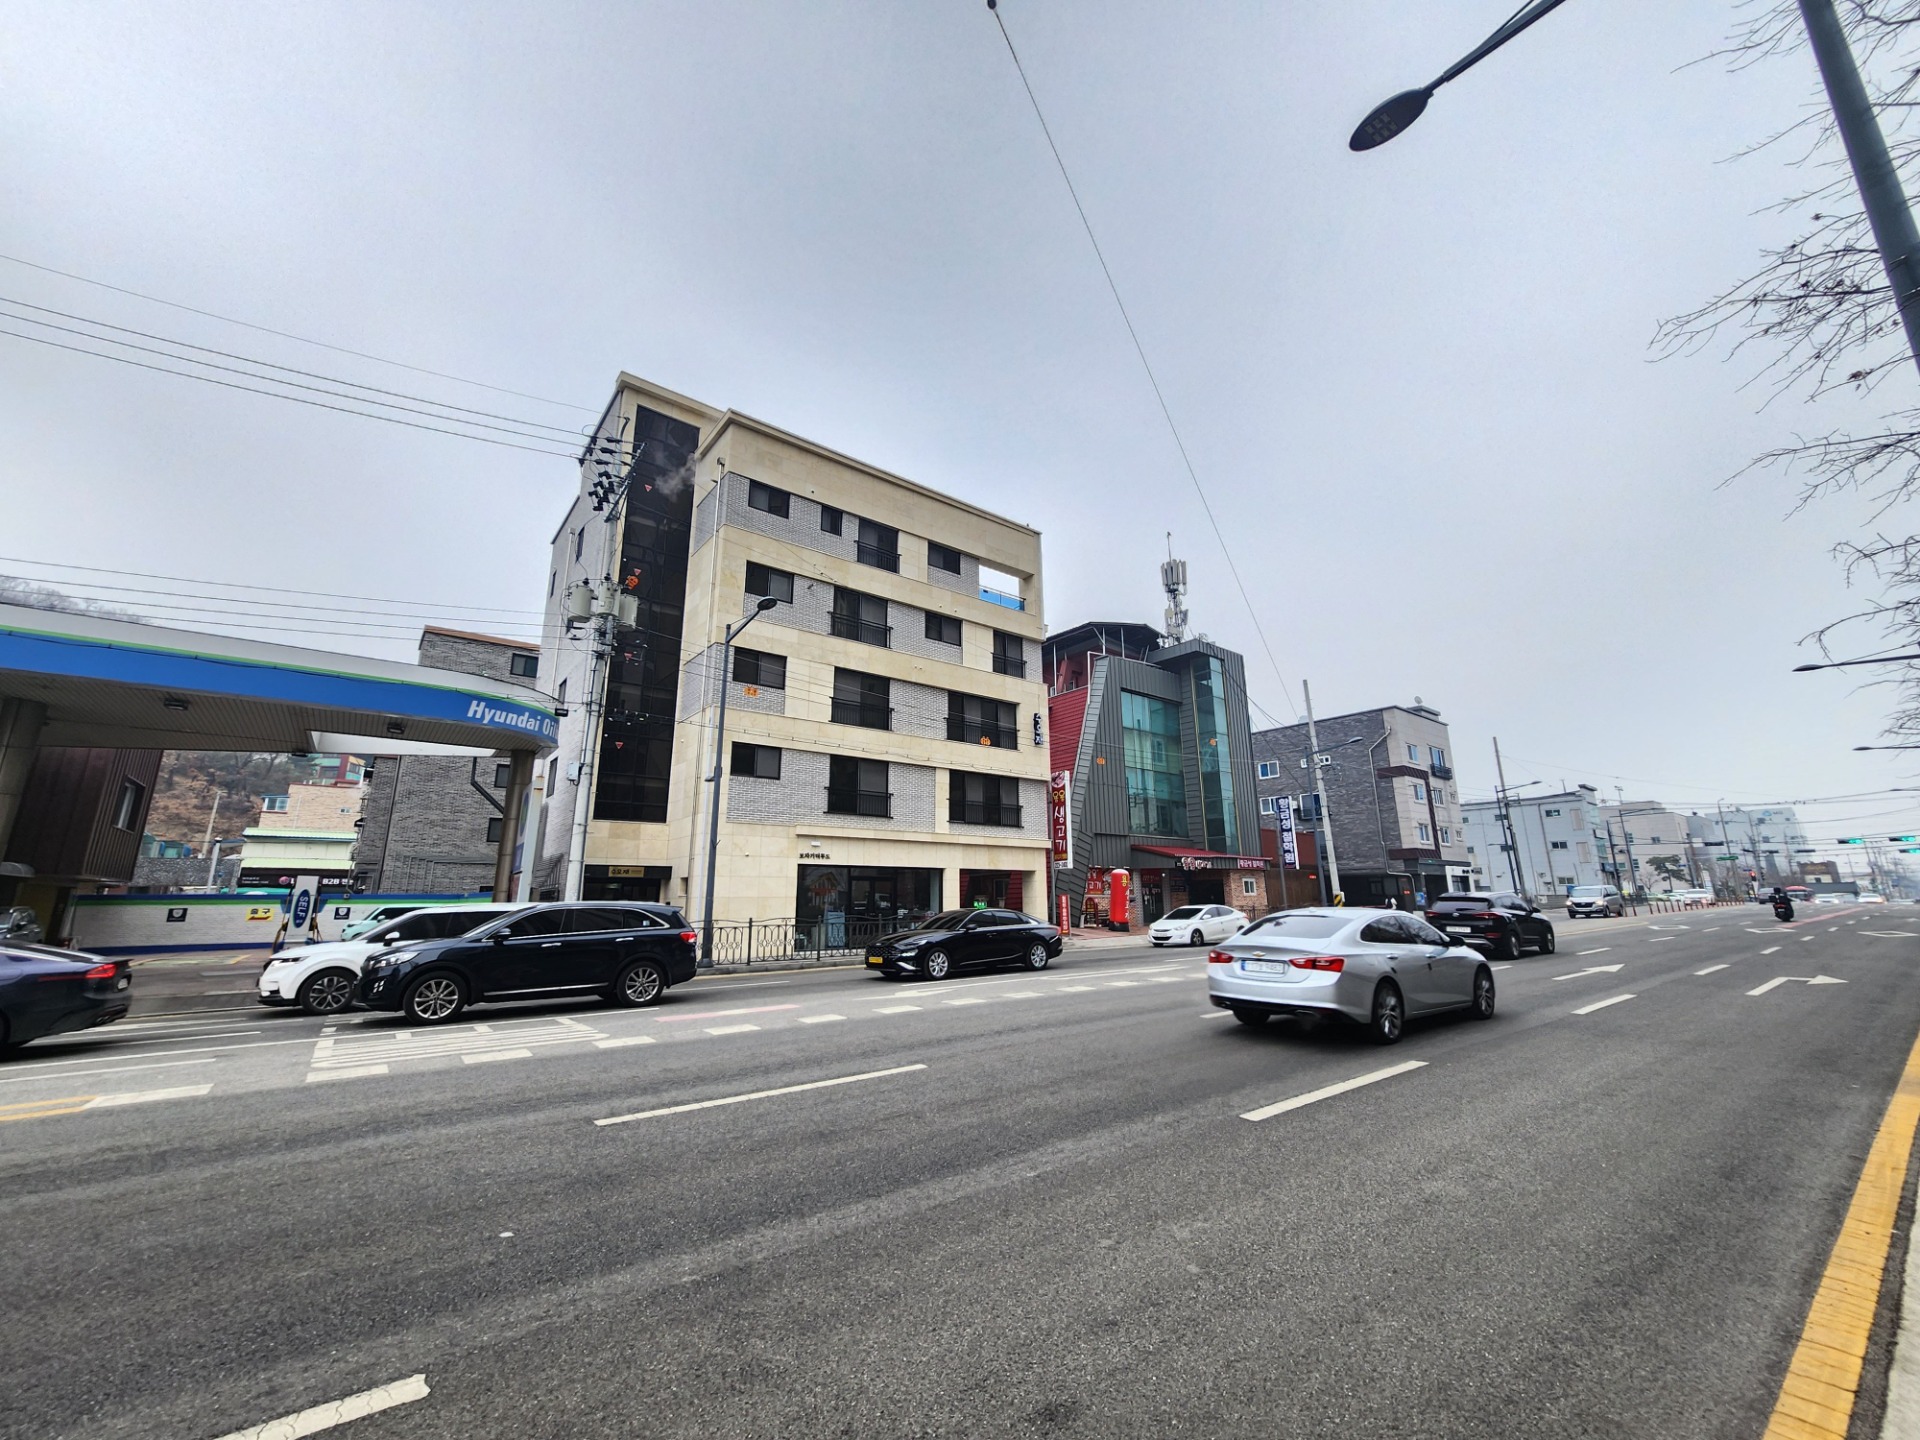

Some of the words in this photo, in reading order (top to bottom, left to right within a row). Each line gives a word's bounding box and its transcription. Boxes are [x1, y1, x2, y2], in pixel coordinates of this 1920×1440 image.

[467, 700, 541, 731] Hyundai
[542, 718, 558, 739] Oil
[1054, 805, 1066, 852] 생고기
[1278, 798, 1291, 829] 황금성
[1282, 831, 1295, 863] 철학원
[297, 896, 309, 918] SELF
